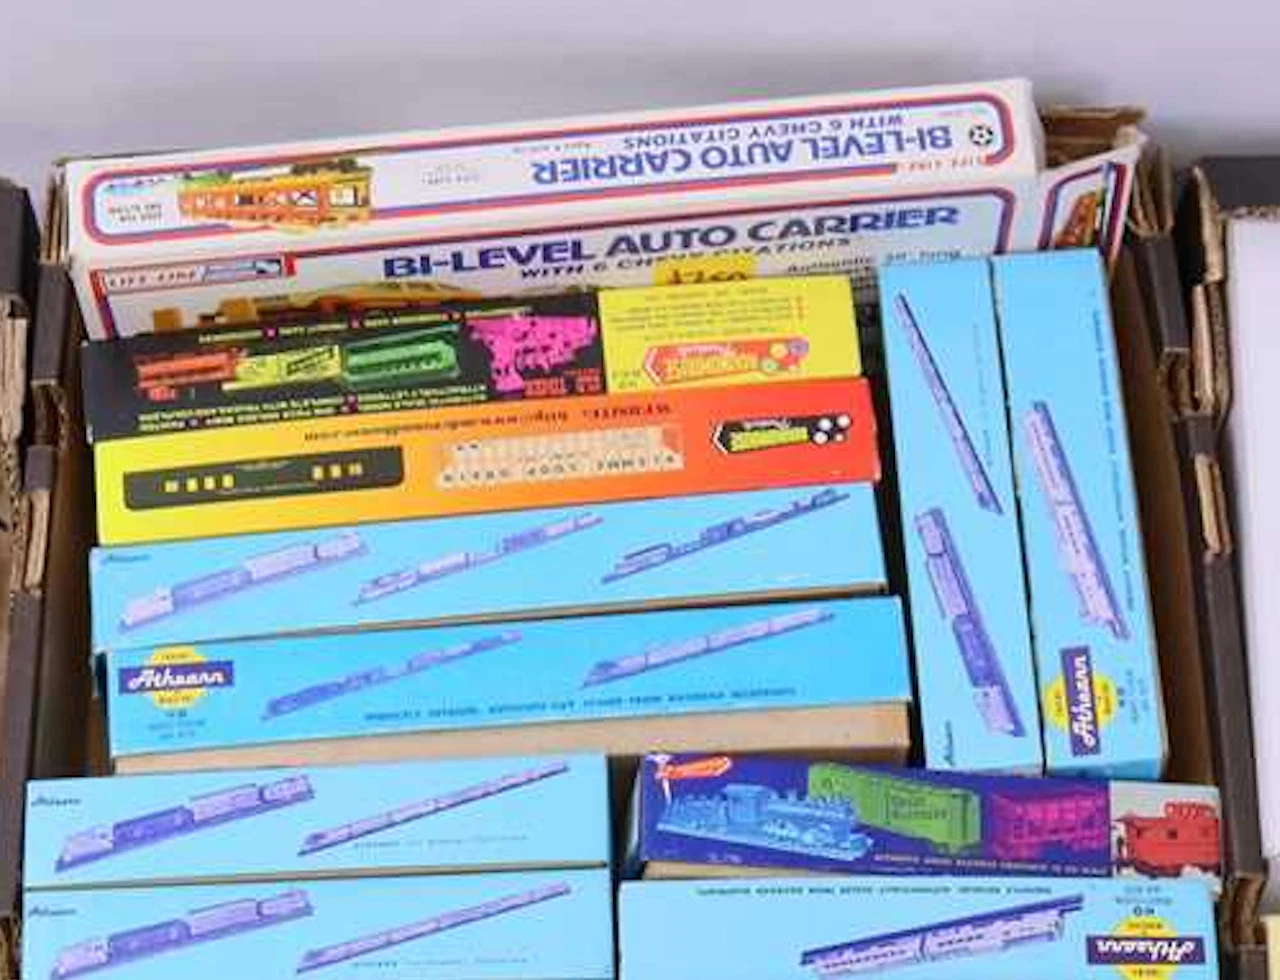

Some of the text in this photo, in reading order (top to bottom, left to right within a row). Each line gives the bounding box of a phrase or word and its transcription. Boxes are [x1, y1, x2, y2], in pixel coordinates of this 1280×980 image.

[750, 119, 824, 142] CHEVY
[849, 113, 903, 132] WITH
[623, 125, 740, 150] CITATIONS
[531, 126, 953, 185] BI-LEVEL AUTO CARRIER
[382, 205, 962, 279] BI-LEVEL AUTO CARRIER
[520, 263, 587, 281] WITH
[1095, 940, 1196, 962] Athearn
